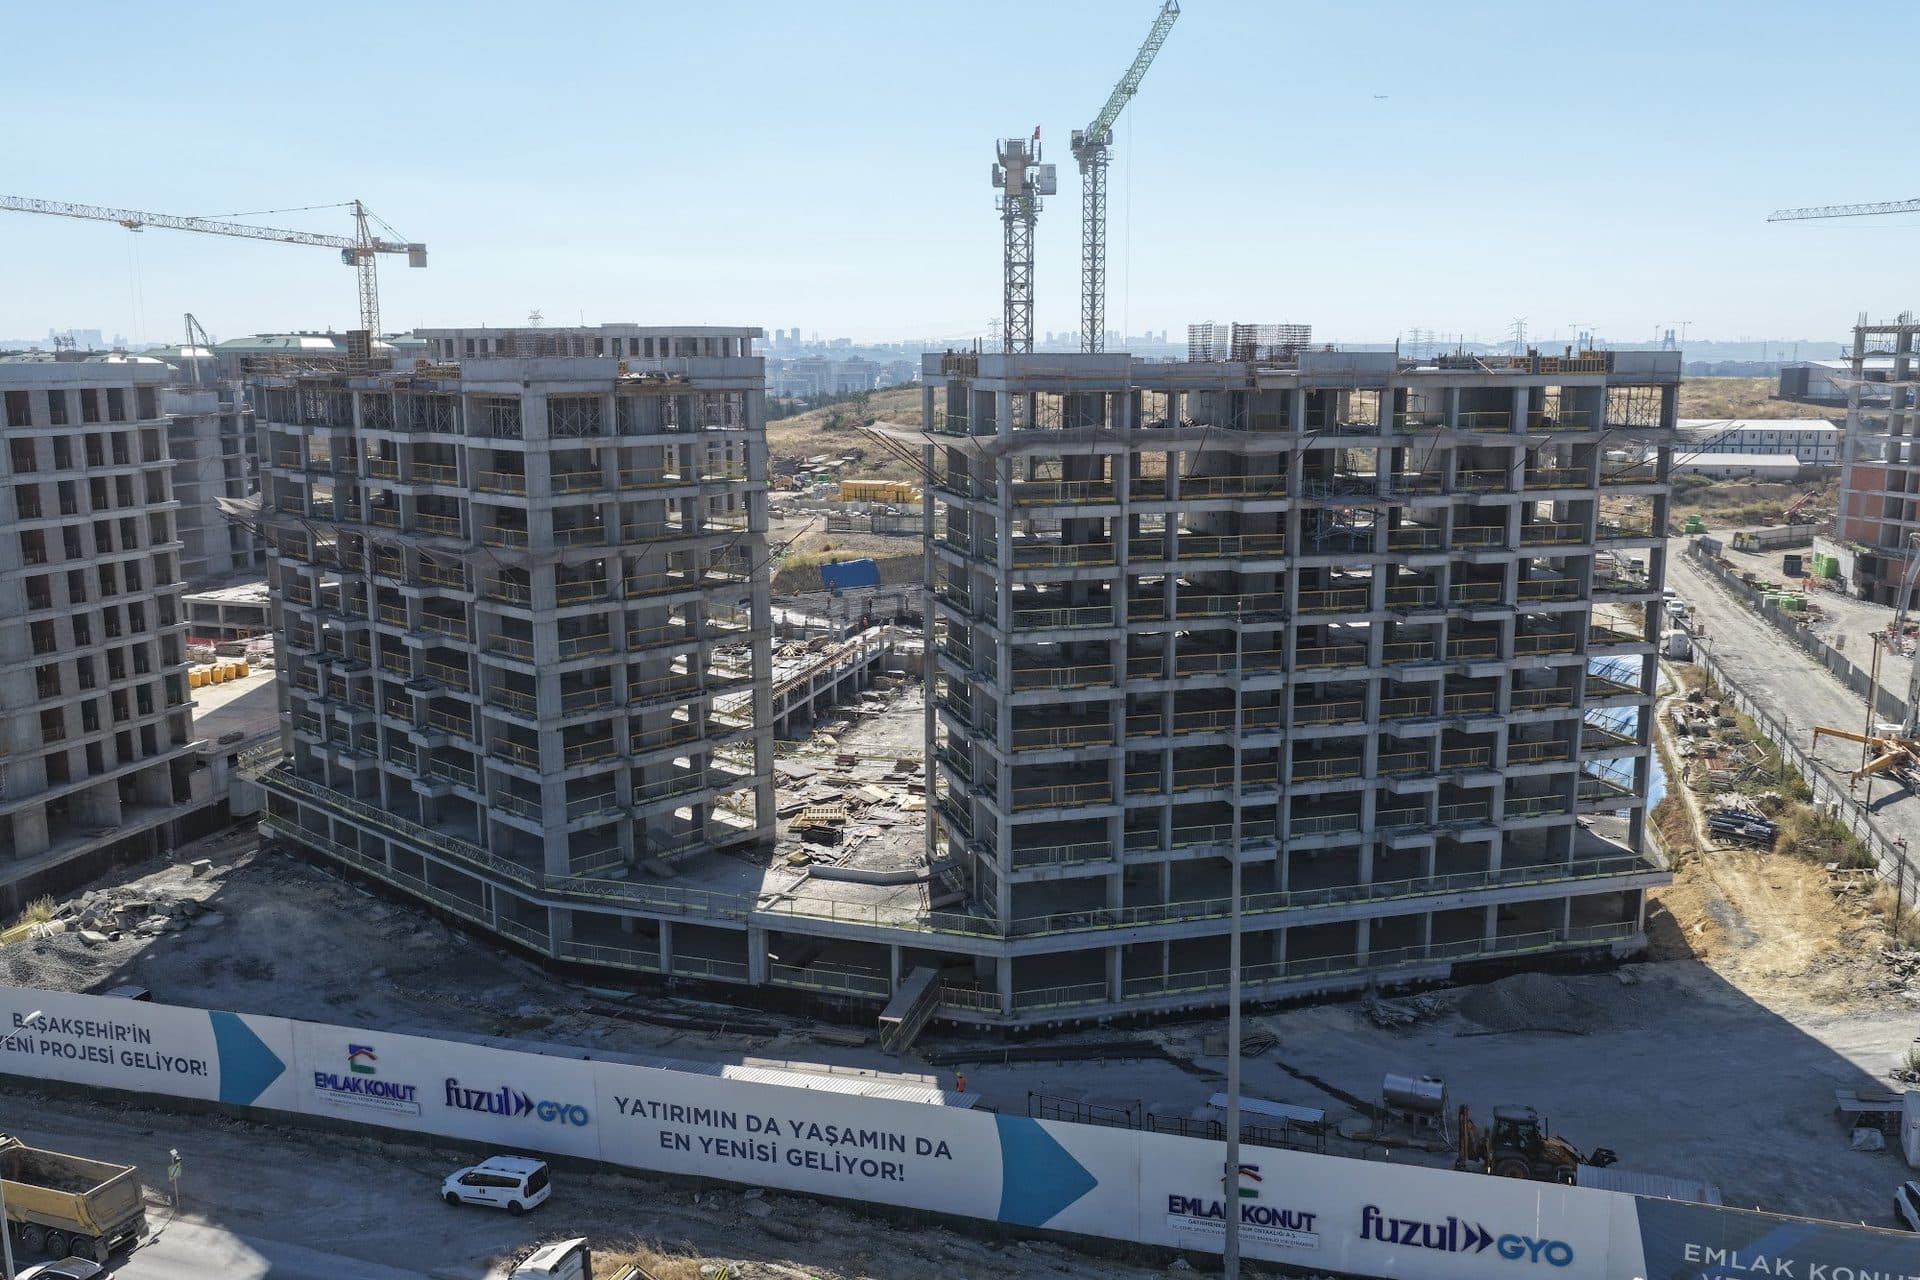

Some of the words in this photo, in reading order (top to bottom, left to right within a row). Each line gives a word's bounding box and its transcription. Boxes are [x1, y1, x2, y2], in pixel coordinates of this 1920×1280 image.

[40, 1040, 115, 1065] PROJESİ
[121, 1051, 208, 1077] GELİYOR!
[315, 1072, 362, 1093] EMLAK
[364, 1079, 416, 1101] KONUT
[445, 1078, 511, 1116] fuzul
[536, 1100, 589, 1127] GYO
[614, 1096, 737, 1130] YATIRIMIN
[746, 1115, 780, 1136] DA
[789, 1119, 906, 1153] YAŞAMIN
[916, 1137, 953, 1160] DA
[660, 1130, 691, 1152] EN
[698, 1136, 777, 1163] YENİSİ
[787, 1149, 904, 1182] GELİYOR!
[1241, 1204, 1317, 1231] KONUT
[1360, 1204, 1458, 1252] fuzul
[1497, 1233, 1574, 1267] GYO
[1684, 1243, 1795, 1278] EMLAK
[1809, 1263, 1920, 1280] KON
